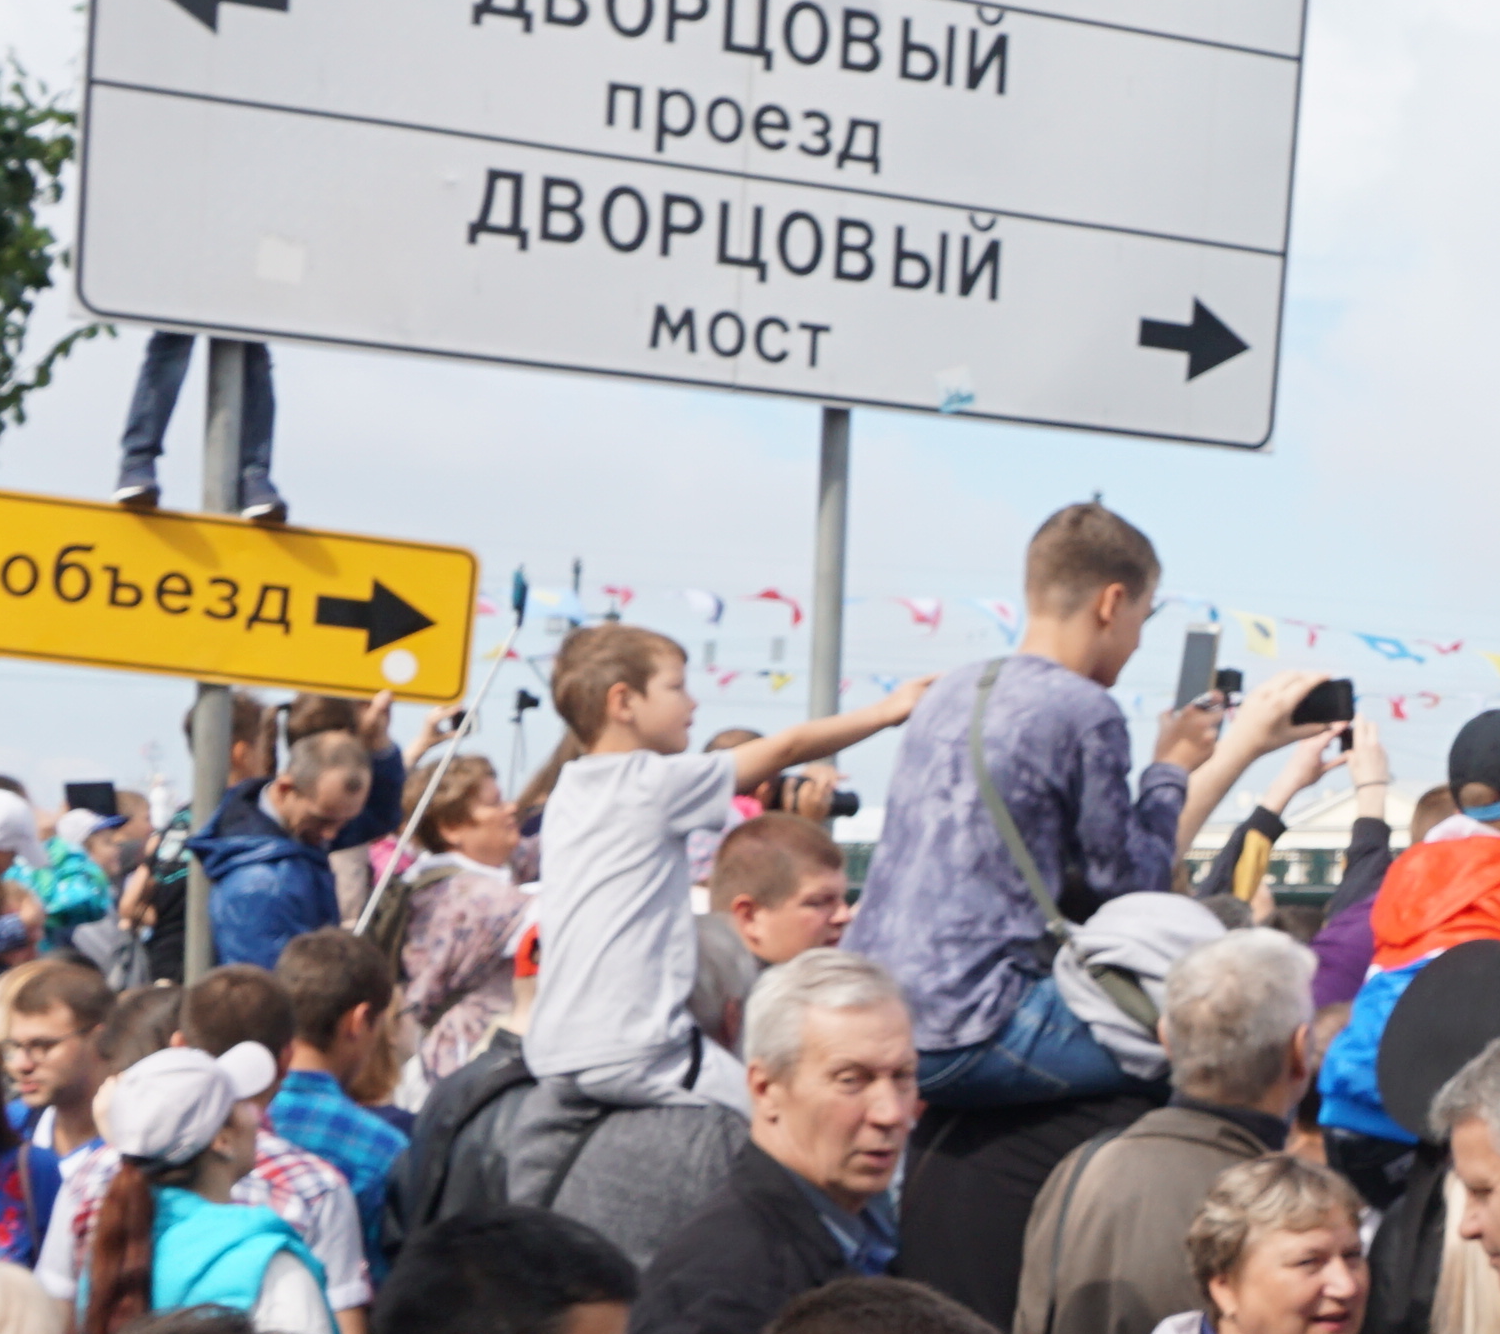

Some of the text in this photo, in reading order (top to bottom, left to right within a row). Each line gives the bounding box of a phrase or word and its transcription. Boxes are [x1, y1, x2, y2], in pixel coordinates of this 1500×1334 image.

[606, 82, 881, 174] проезд
[467, 168, 1001, 301] ДВОРЦОВЫЙ
[649, 304, 831, 368] мост
[0, 544, 291, 634] объезд
